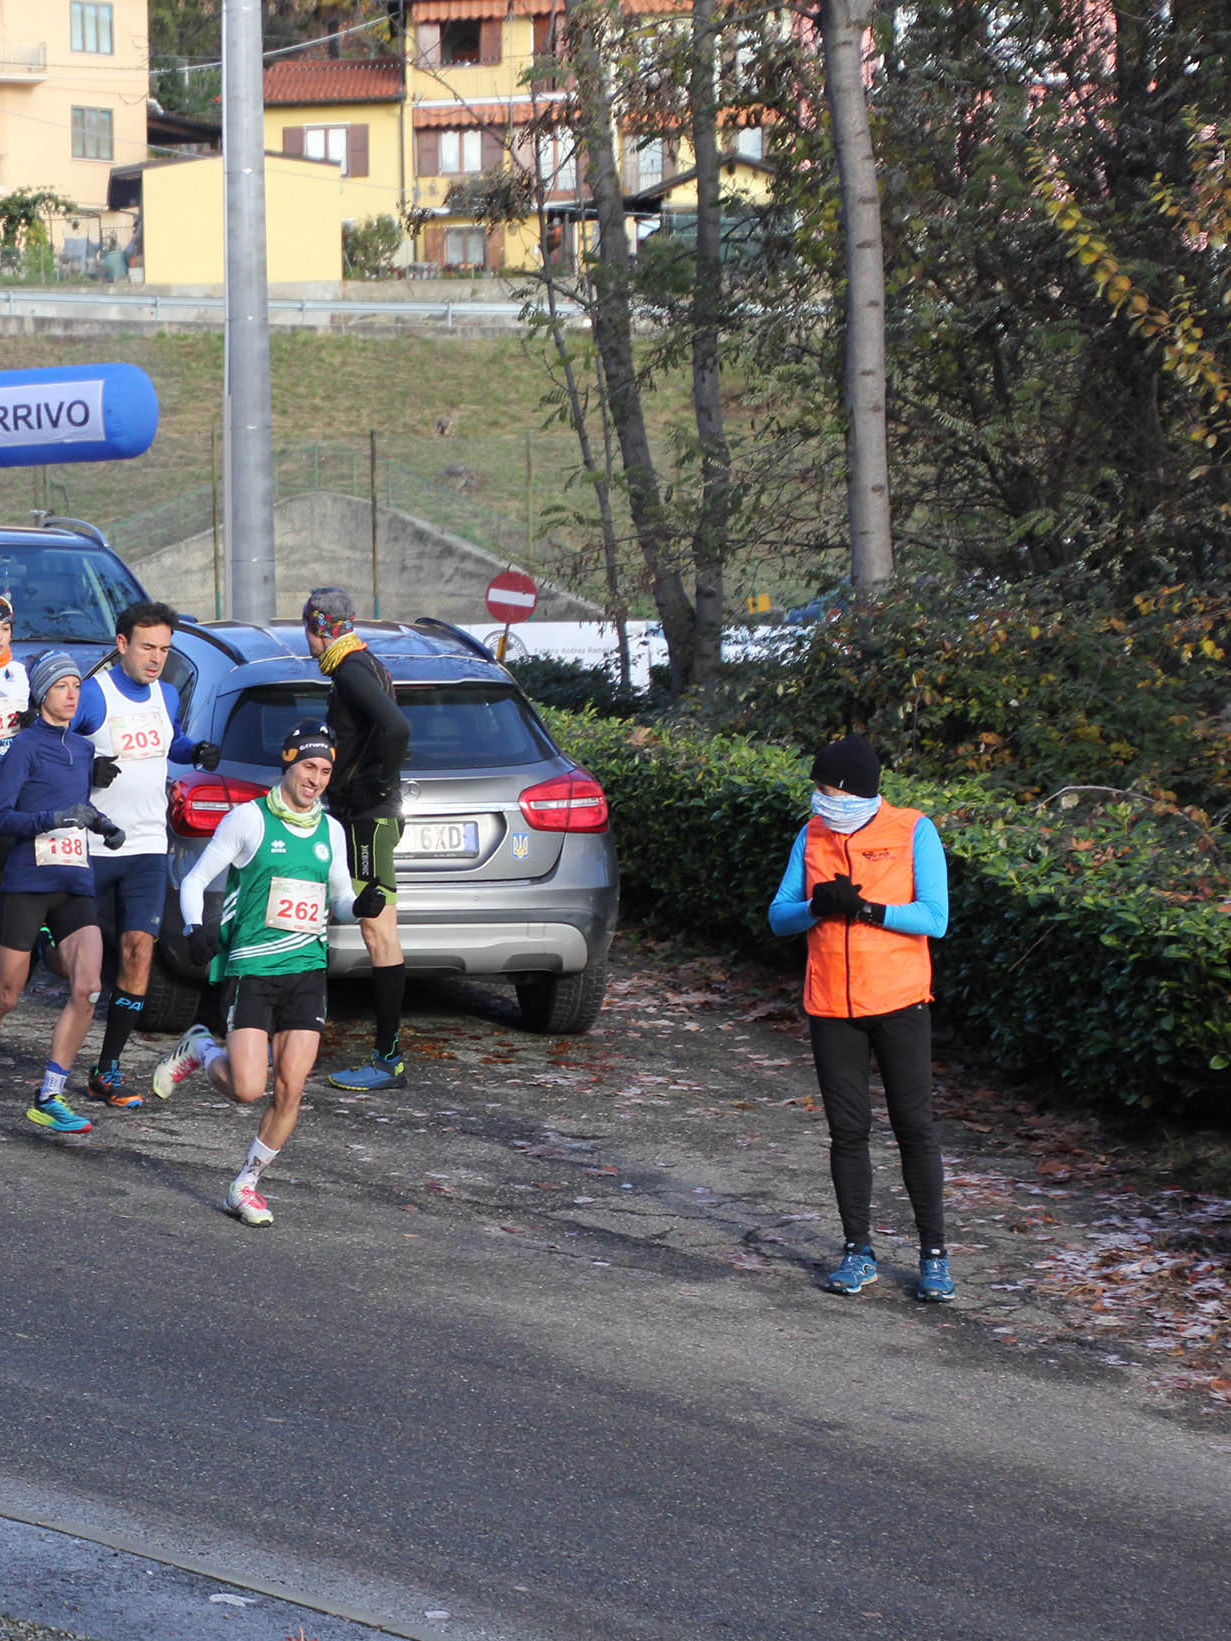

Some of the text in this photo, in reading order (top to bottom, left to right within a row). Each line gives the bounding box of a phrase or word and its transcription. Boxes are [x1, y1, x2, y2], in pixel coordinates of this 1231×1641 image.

[122, 729, 161, 751] 203
[49, 837, 83, 857] 188
[277, 899, 319, 922] 262
